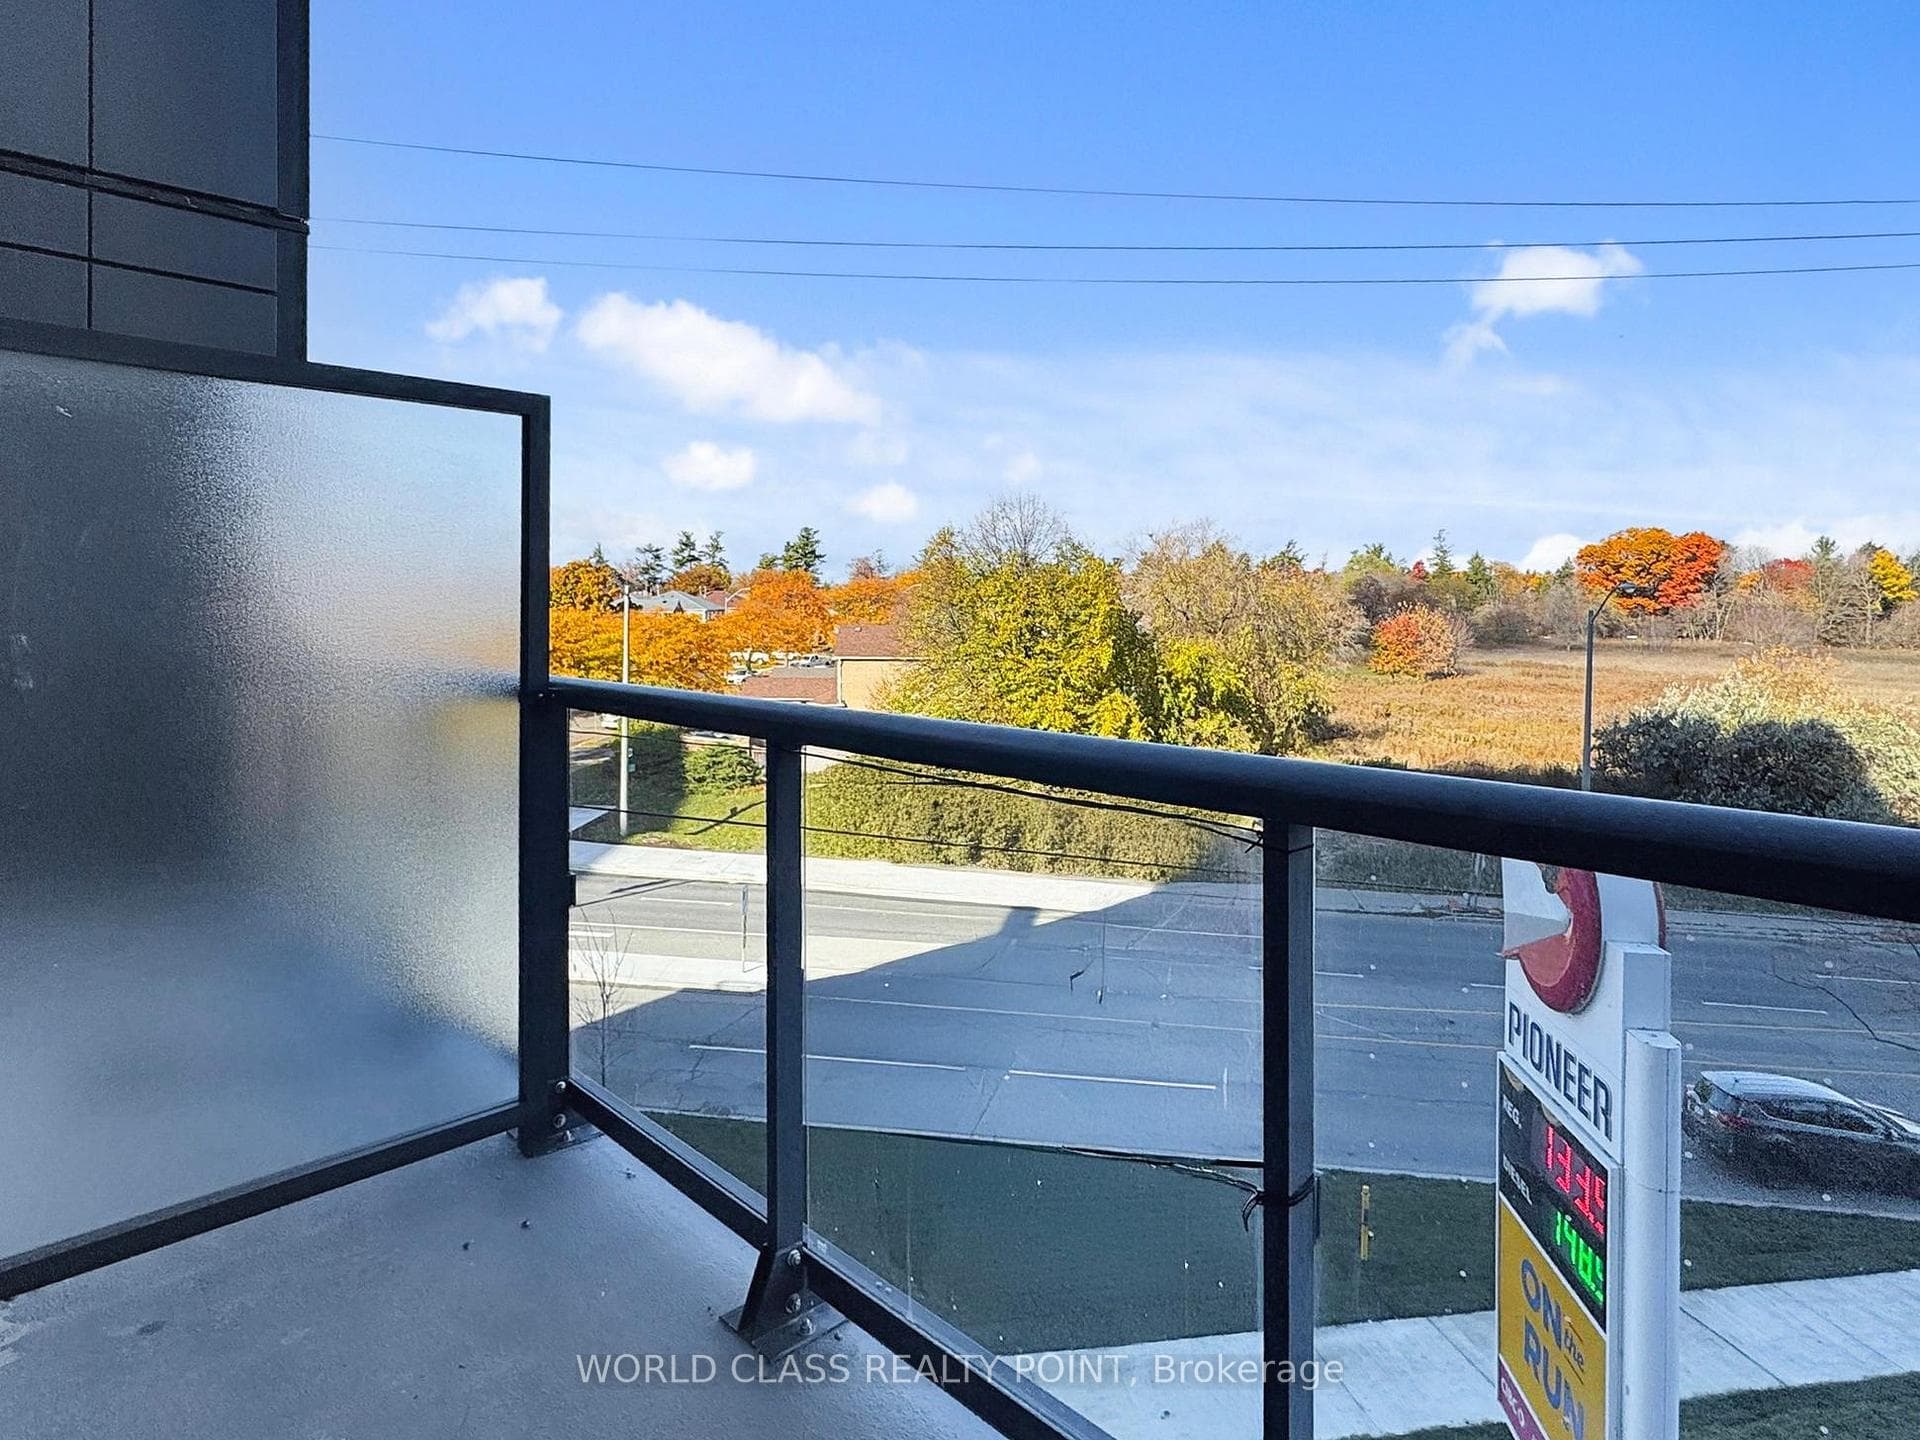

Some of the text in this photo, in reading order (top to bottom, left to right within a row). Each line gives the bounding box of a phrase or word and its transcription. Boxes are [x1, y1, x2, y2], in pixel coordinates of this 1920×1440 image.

[1508, 1001, 1612, 1142] PIONEER
[1521, 1259, 1585, 1366] ON the
[1524, 1316, 1585, 1440] RUN
